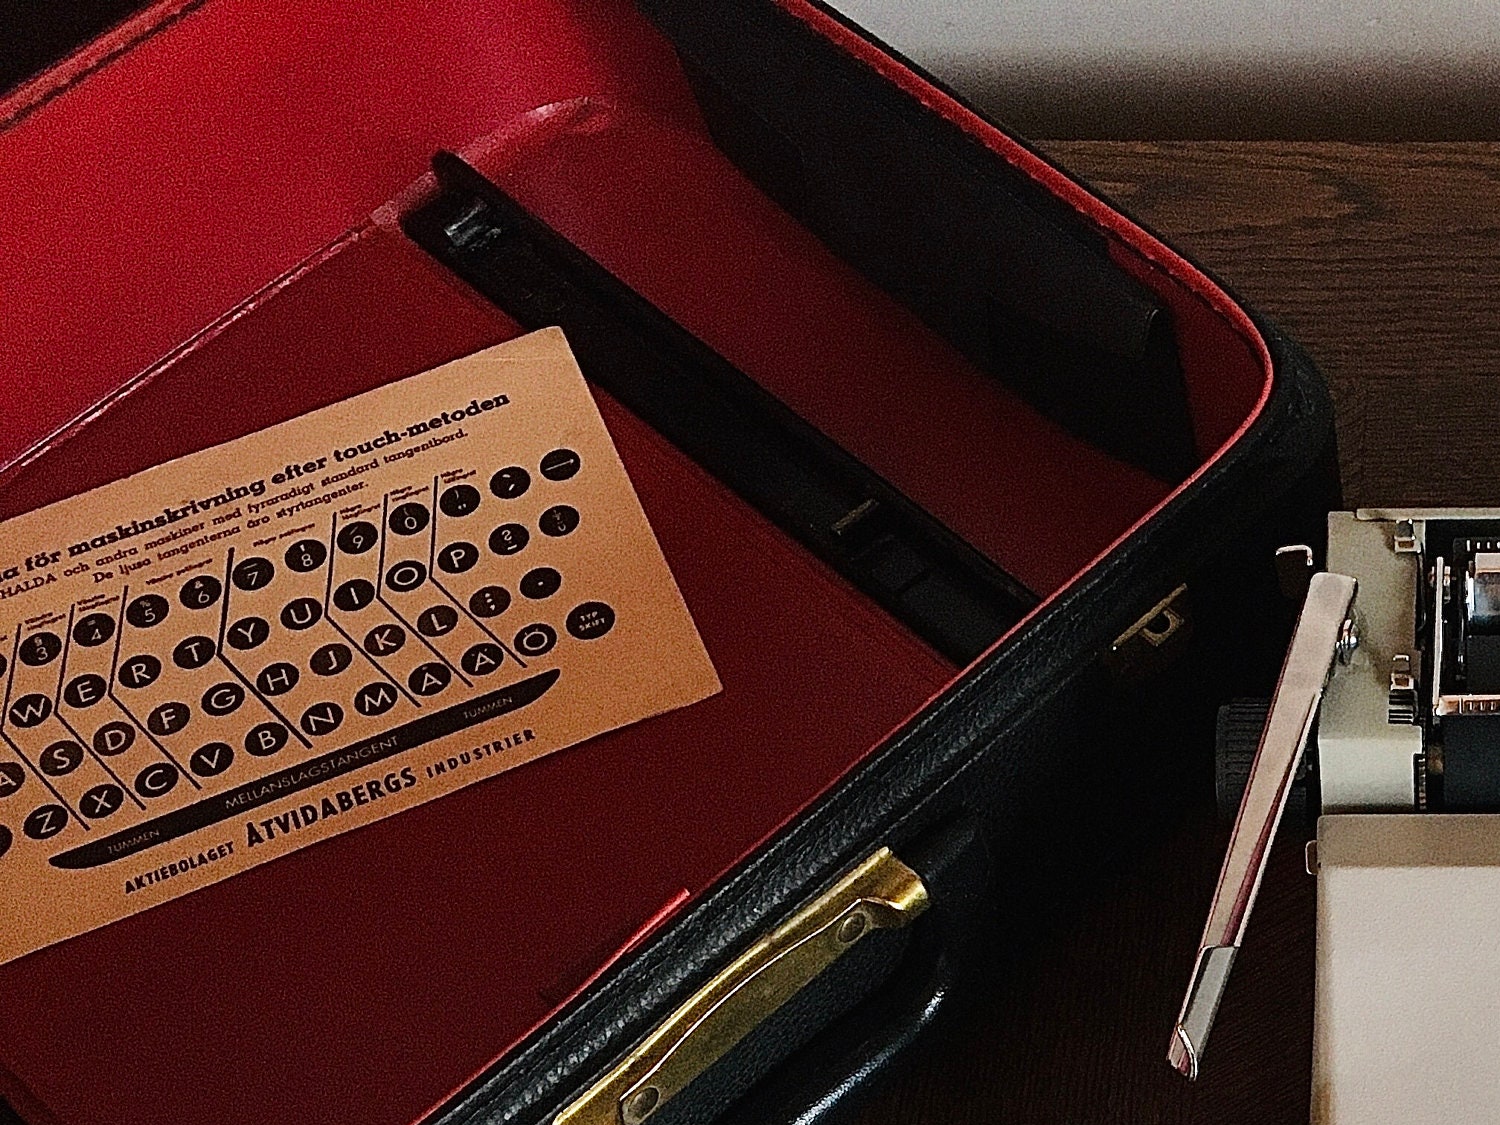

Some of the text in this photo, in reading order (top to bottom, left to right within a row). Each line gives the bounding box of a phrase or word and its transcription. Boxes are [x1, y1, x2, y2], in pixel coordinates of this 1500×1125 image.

[25, 551, 61, 572] för
[68, 479, 266, 557] maskinskrivning
[271, 456, 328, 485] efter
[333, 393, 511, 462] touch-metoden
[64, 561, 90, 578] och
[95, 546, 138, 567] andra
[144, 521, 205, 551] maskiner
[212, 507, 242, 526] med
[320, 458, 379, 487] standard
[383, 428, 469, 464] tangentbord.
[93, 571, 113, 584] De
[157, 526, 241, 561] tangenterna
[12, 697, 47, 724] W
[77, 680, 96, 703] E
[131, 663, 151, 683] R
[184, 642, 200, 662] T
[237, 622, 255, 643] Y
[288, 601, 312, 624] U
[350, 587, 359, 605] I
[393, 566, 420, 587] O
[450, 549, 466, 568] P
[36, 646, 48, 661] 3
[91, 628, 102, 640] 4
[144, 608, 156, 623] 5
[198, 590, 210, 604] 6
[247, 571, 259, 586] 7
[301, 553, 313, 567] 8
[352, 535, 364, 549] 9
[35, 810, 57, 834] Z
[88, 788, 112, 813] X
[143, 767, 167, 790] C
[199, 748, 220, 769] V
[257, 730, 276, 750] B
[307, 705, 336, 733] N
[364, 687, 394, 714] M
[53, 748, 70, 769] S
[104, 729, 126, 751] D
[160, 708, 176, 729] F
[210, 688, 238, 711] G
[265, 667, 291, 693] H
[328, 650, 338, 670] J
[373, 628, 397, 651] K
[430, 613, 448, 631] L
[125, 840, 235, 894] AKTIEBOLAGET
[425, 728, 536, 779] INDUSTRIER
[225, 735, 399, 810] MELLANSLAGSTANGENT
